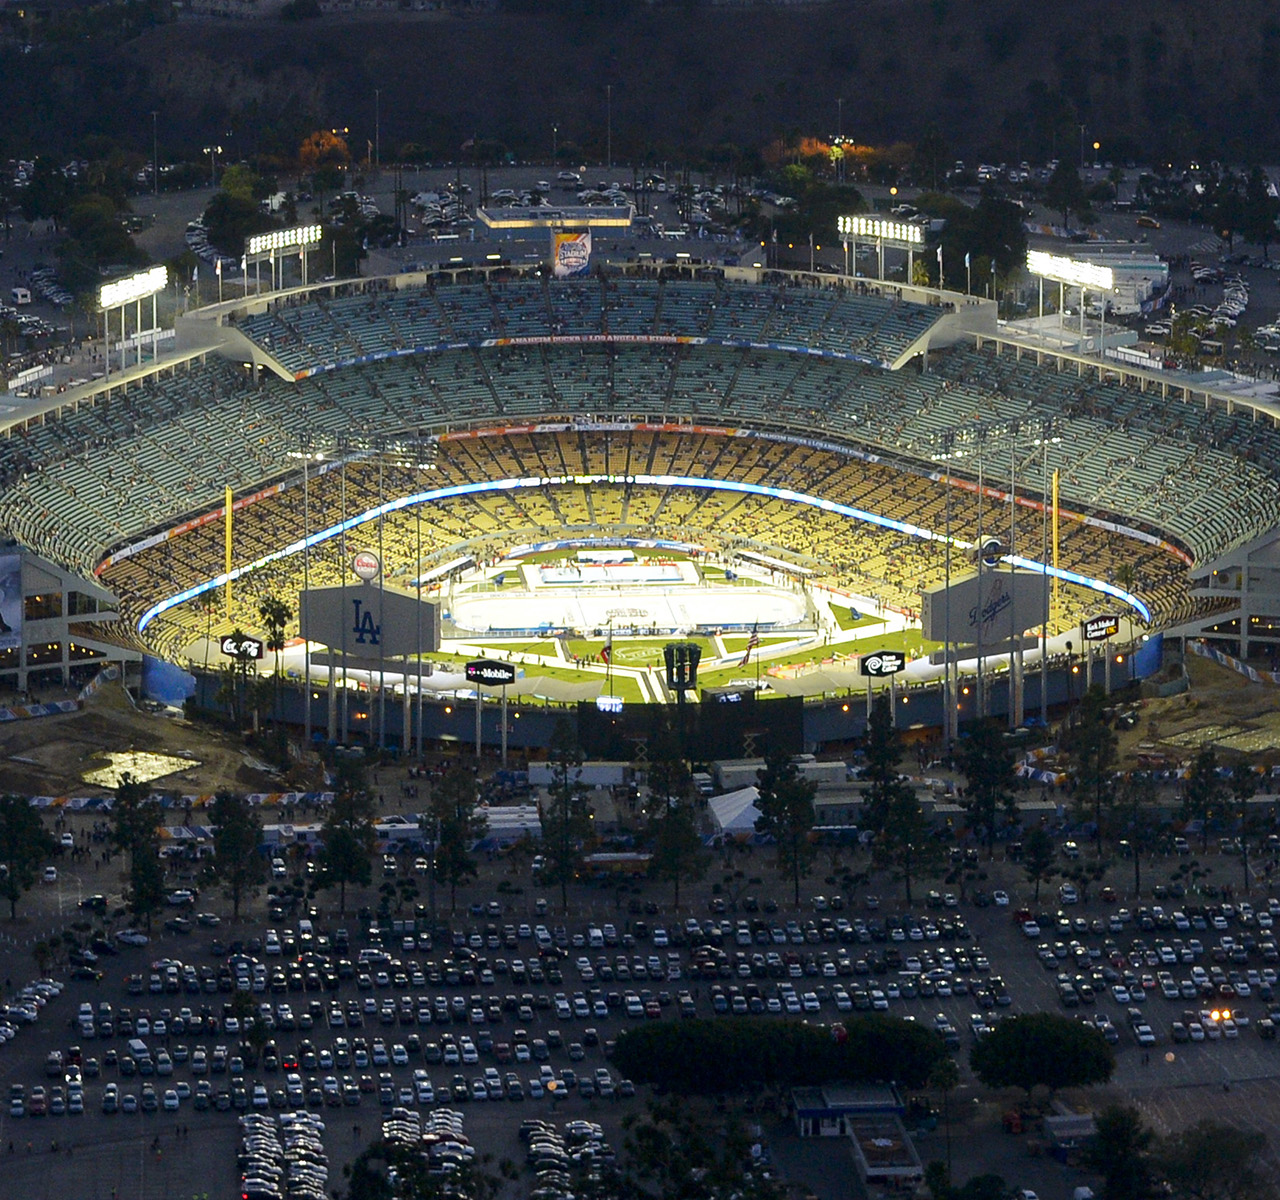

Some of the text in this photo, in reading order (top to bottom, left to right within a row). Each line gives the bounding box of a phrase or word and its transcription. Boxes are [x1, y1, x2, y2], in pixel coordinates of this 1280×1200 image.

[510, 336, 551, 344] ANAHEIM
[356, 559, 377, 569] Coors
[353, 599, 380, 645] LA
